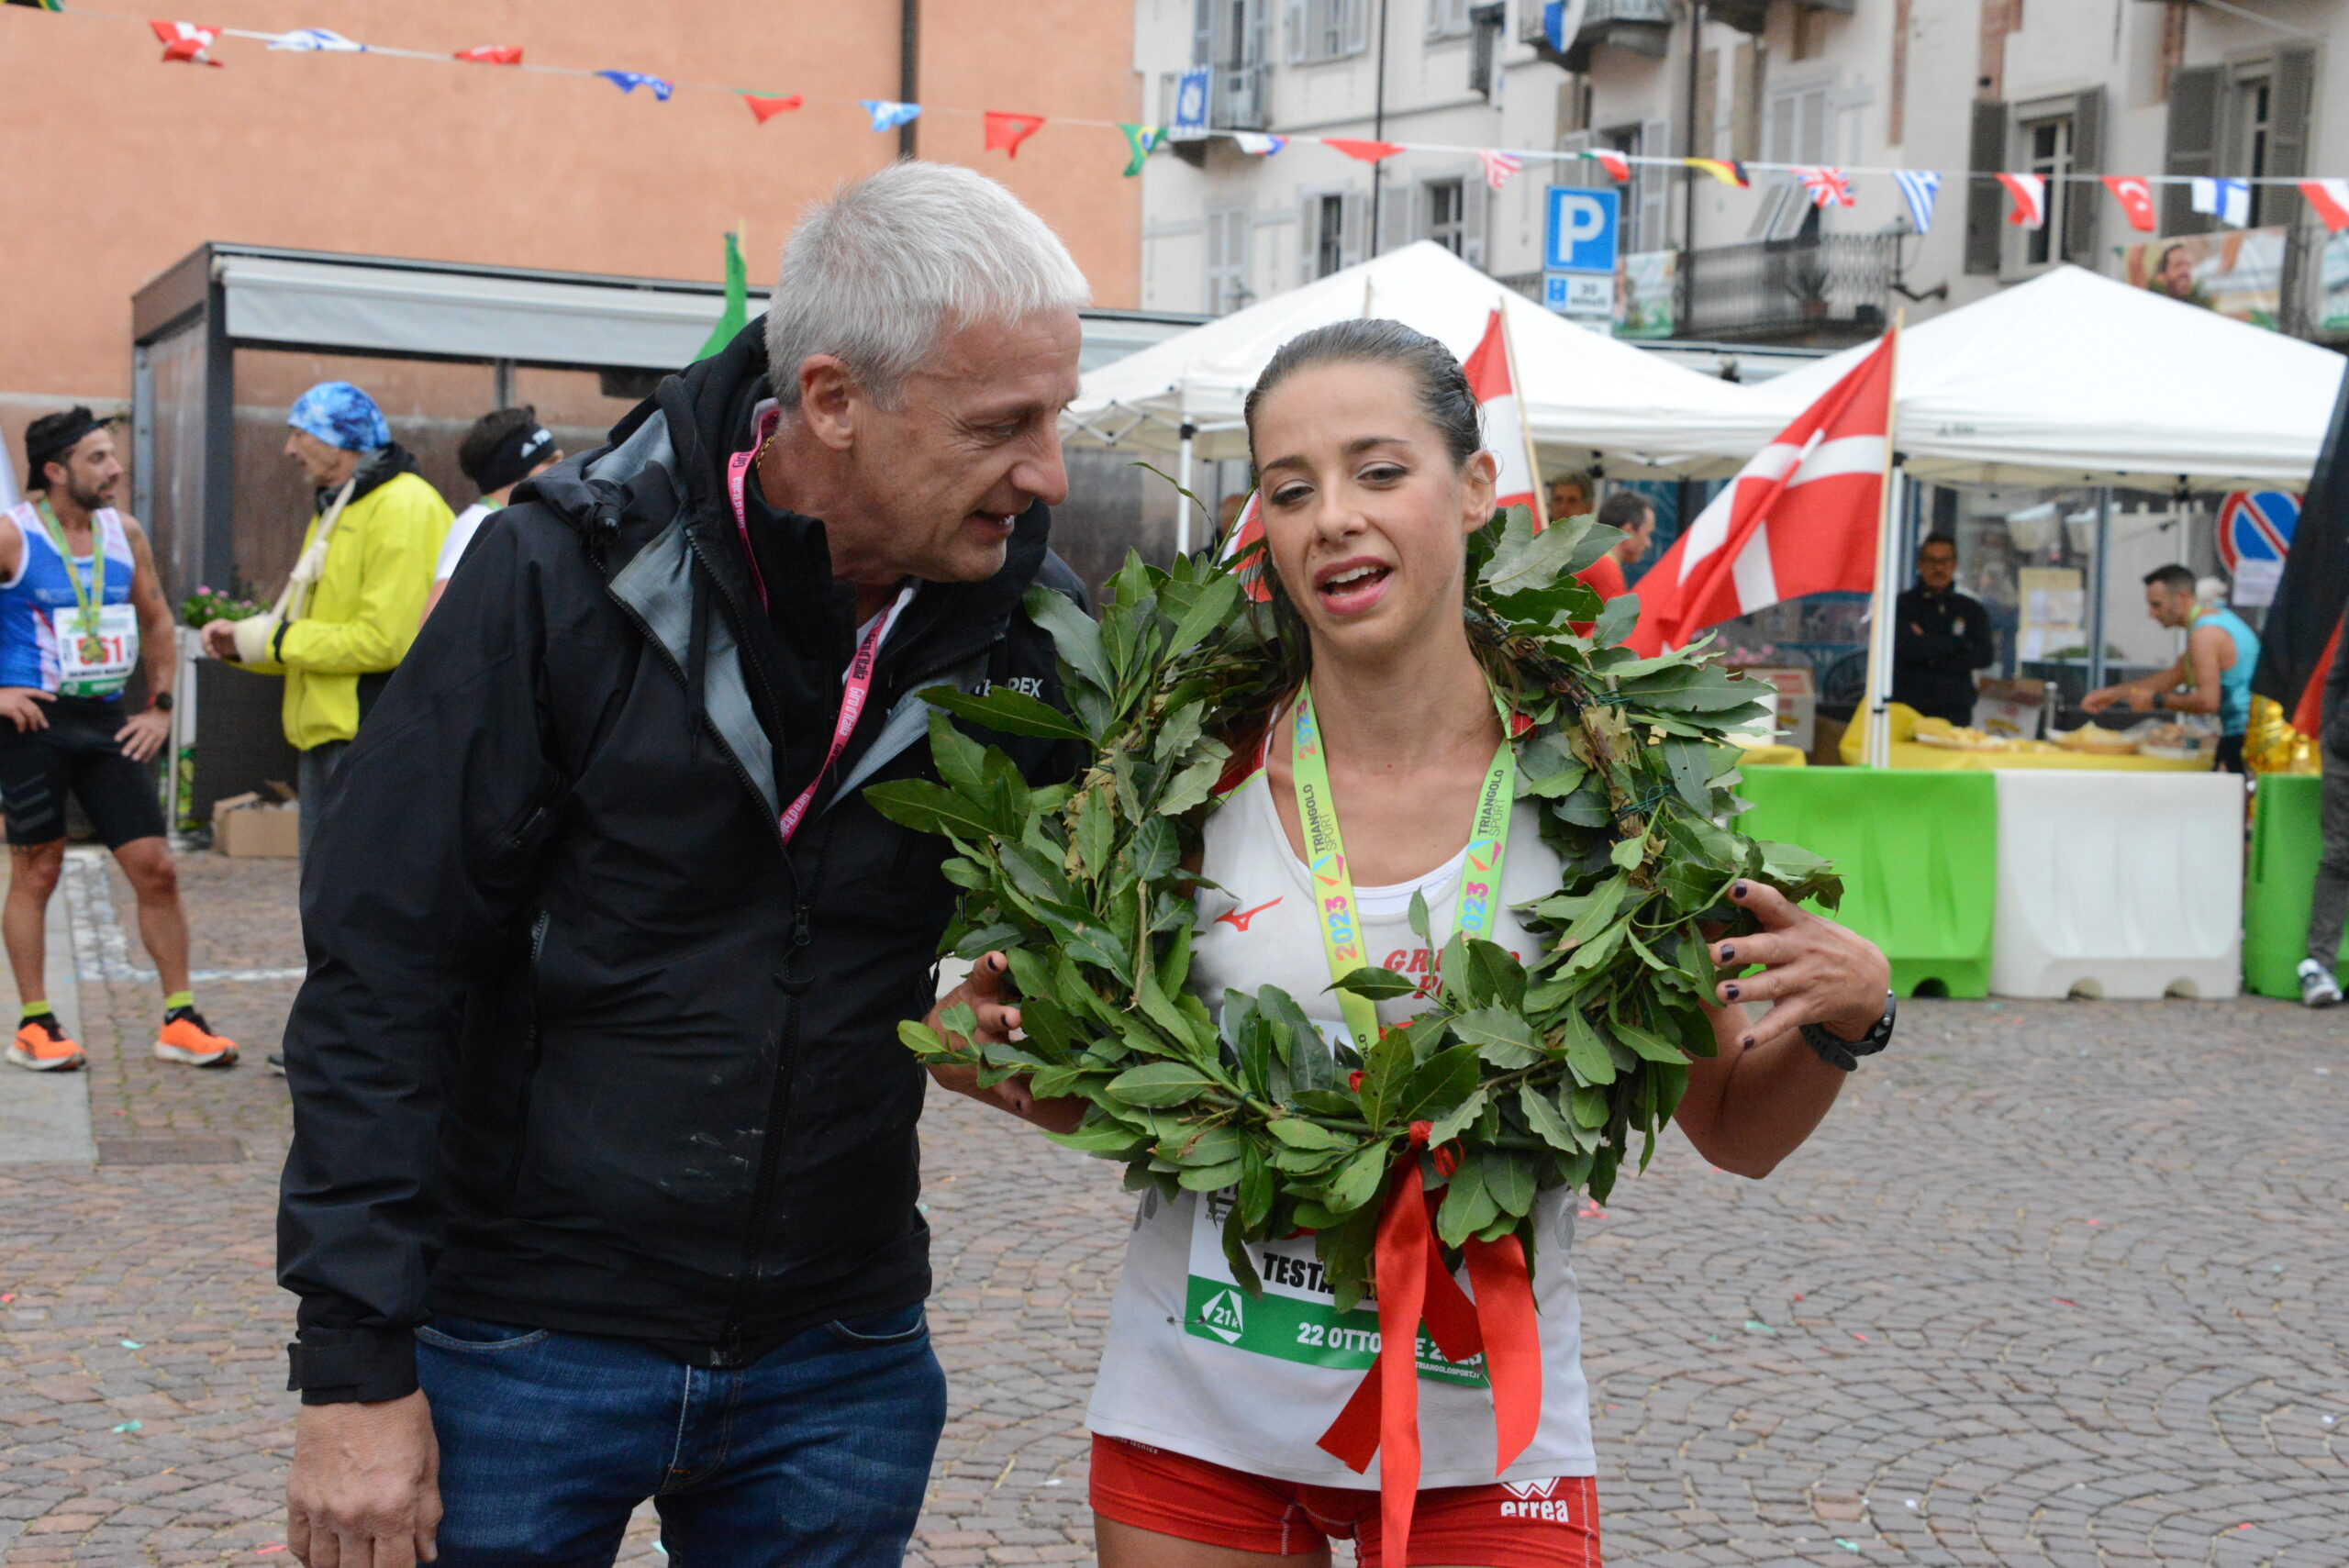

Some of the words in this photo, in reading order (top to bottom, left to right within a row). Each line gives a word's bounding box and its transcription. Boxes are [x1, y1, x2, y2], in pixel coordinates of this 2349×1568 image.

[1558, 195, 1606, 263] P
[847, 686, 865, 706] Giro
[839, 706, 859, 736] d'Italia
[1297, 699, 1316, 760] 2023
[794, 793, 810, 812] Giro
[1303, 784, 1325, 854] TRIANGOLO
[1478, 770, 1504, 836] TRIANGOLO
[1489, 799, 1506, 837] SPORT
[1319, 814, 1337, 851] SPORT
[1324, 895, 1357, 962] 2023
[1297, 1322, 1324, 1347] 22
[1328, 1327, 1426, 1358] OTTOE
